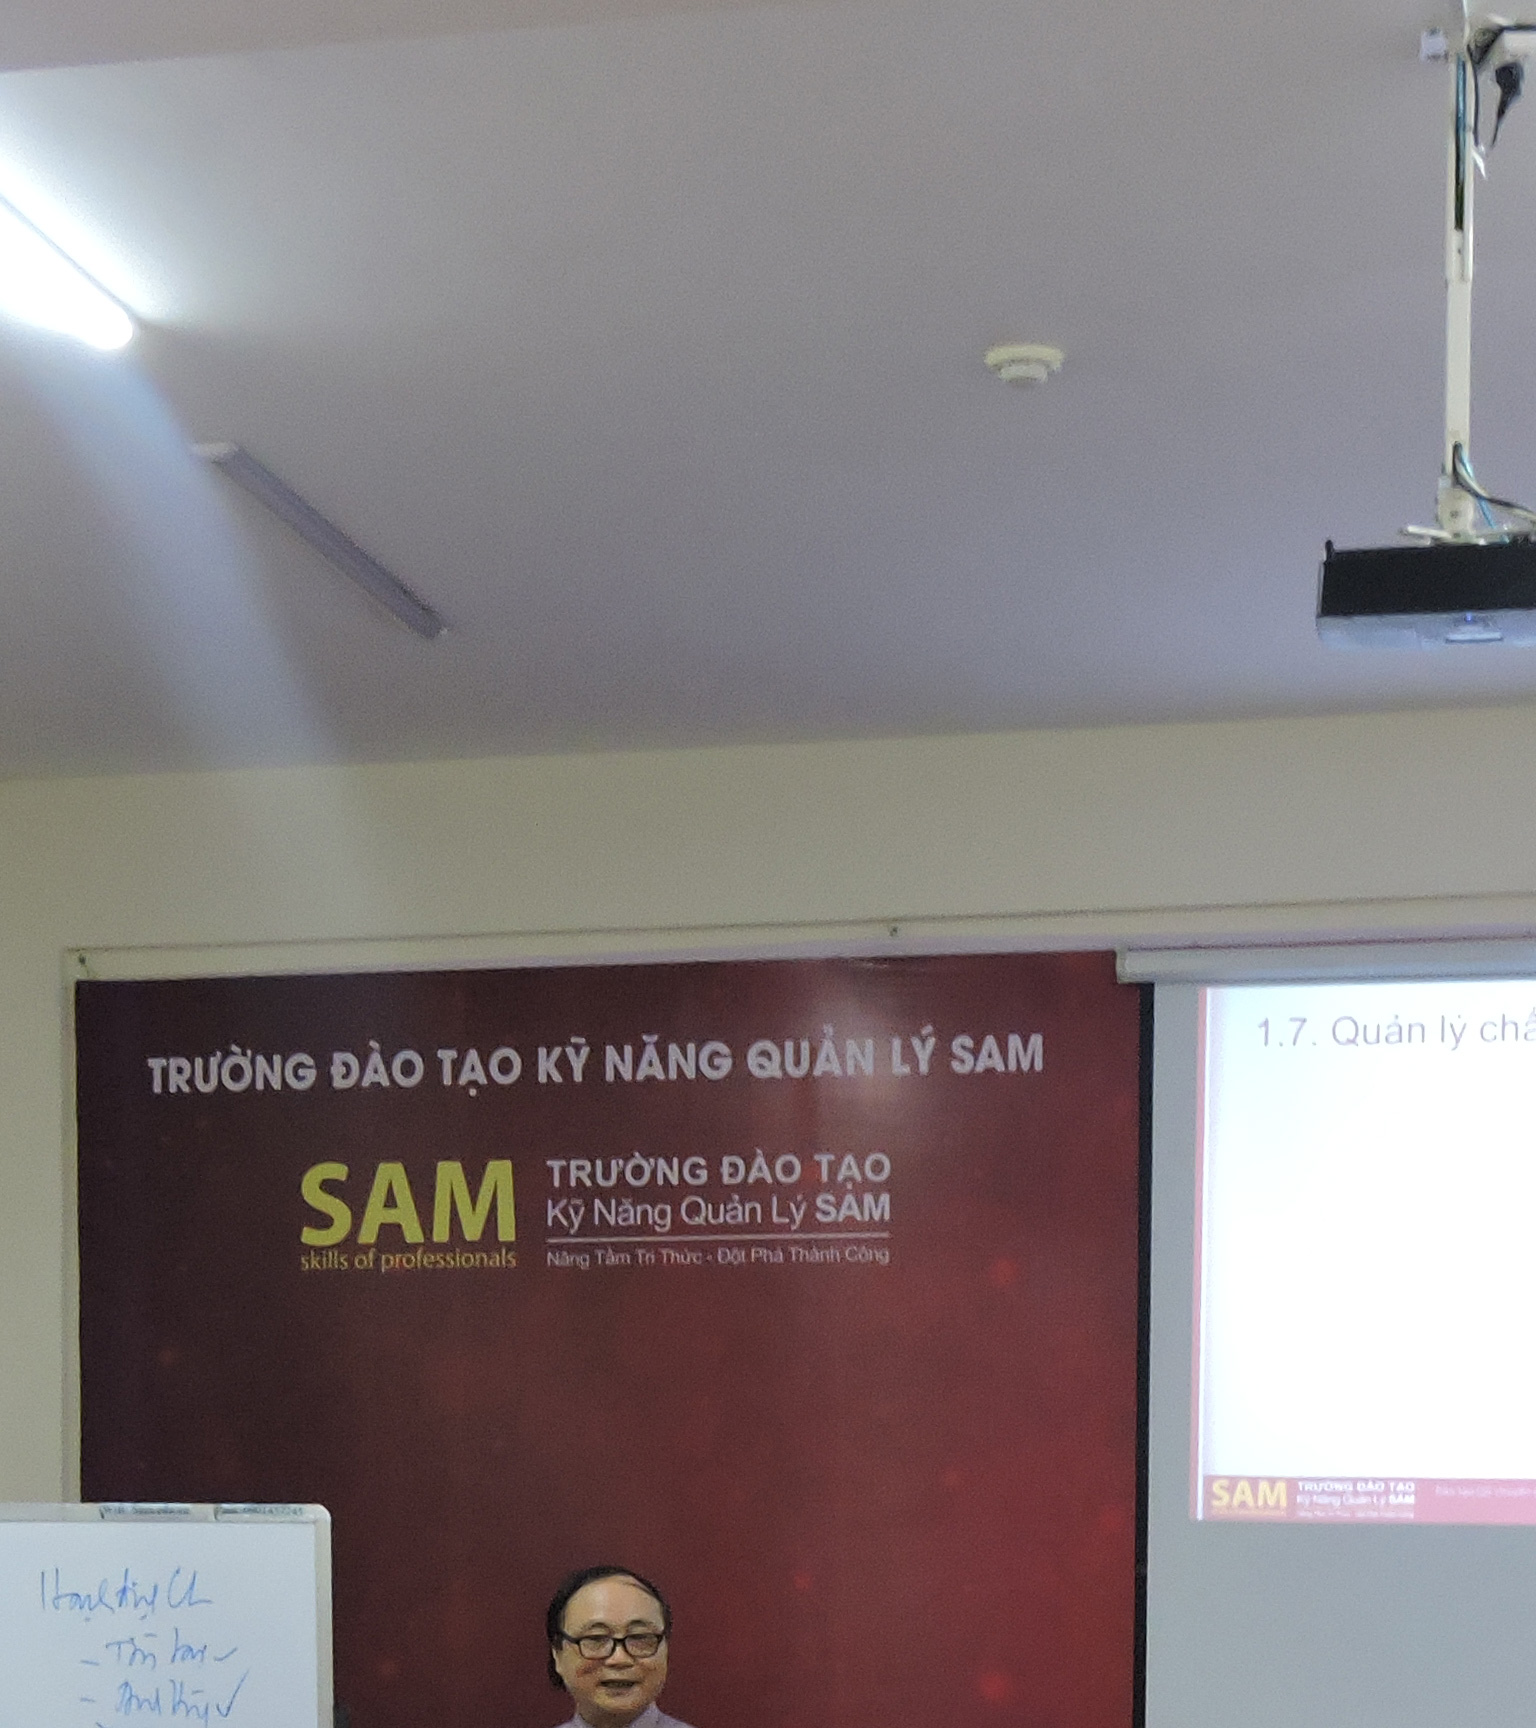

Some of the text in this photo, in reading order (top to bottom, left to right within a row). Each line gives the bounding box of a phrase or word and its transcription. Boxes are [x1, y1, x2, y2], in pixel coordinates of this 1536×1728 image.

[1257, 1016, 1317, 1047] 1.7.
[1332, 1014, 1426, 1047] Quản
[1440, 1013, 1467, 1051] lý
[147, 1022, 1045, 1097] TRƯỜNG ĐÀO TẠO KỸ NĂNG QUẢN LÝ SAM
[546, 1148, 892, 1190] TRƯỜNG ĐÀO TẠO
[300, 1159, 517, 1247] SAM
[547, 1192, 891, 1235] Kỹ Năng Quản Lý SAM
[301, 1247, 517, 1273] skills of professionals
[1210, 1478, 1288, 1508] SAM
